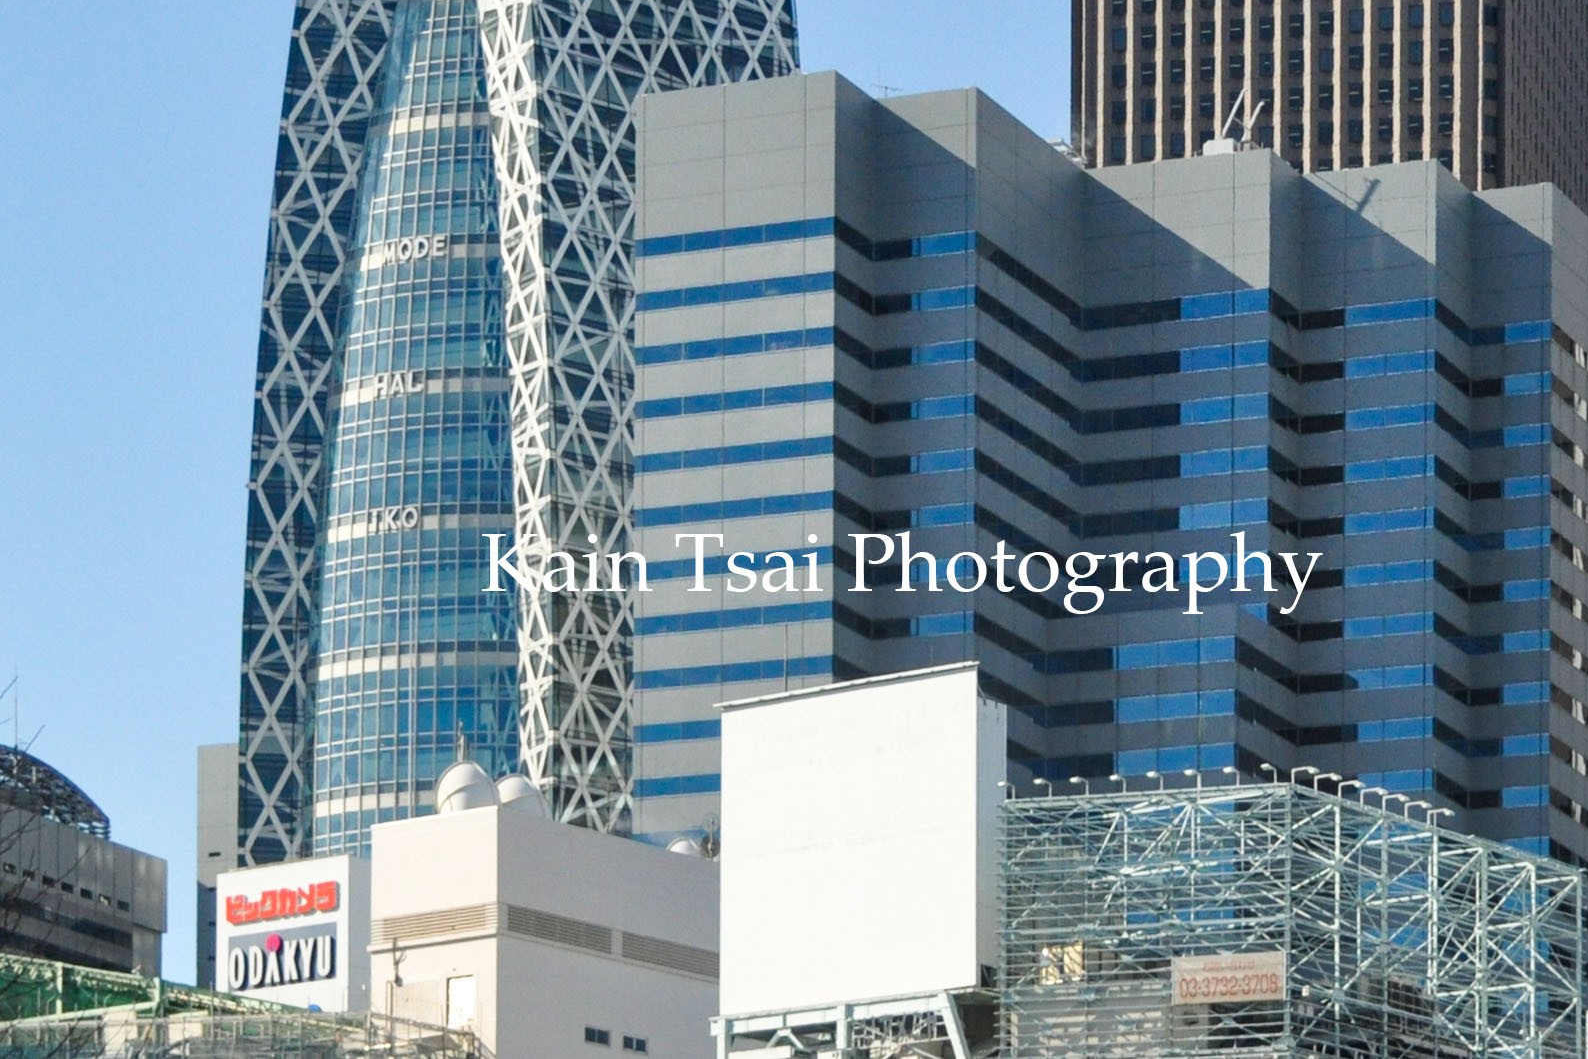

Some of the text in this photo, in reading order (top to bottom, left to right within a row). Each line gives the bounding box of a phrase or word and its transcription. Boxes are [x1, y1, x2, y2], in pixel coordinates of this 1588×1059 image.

[384, 236, 446, 264] MODE
[374, 372, 425, 398] HAL
[226, 880, 339, 926] ビックカメラ
[229, 933, 332, 990] ODAKYU
